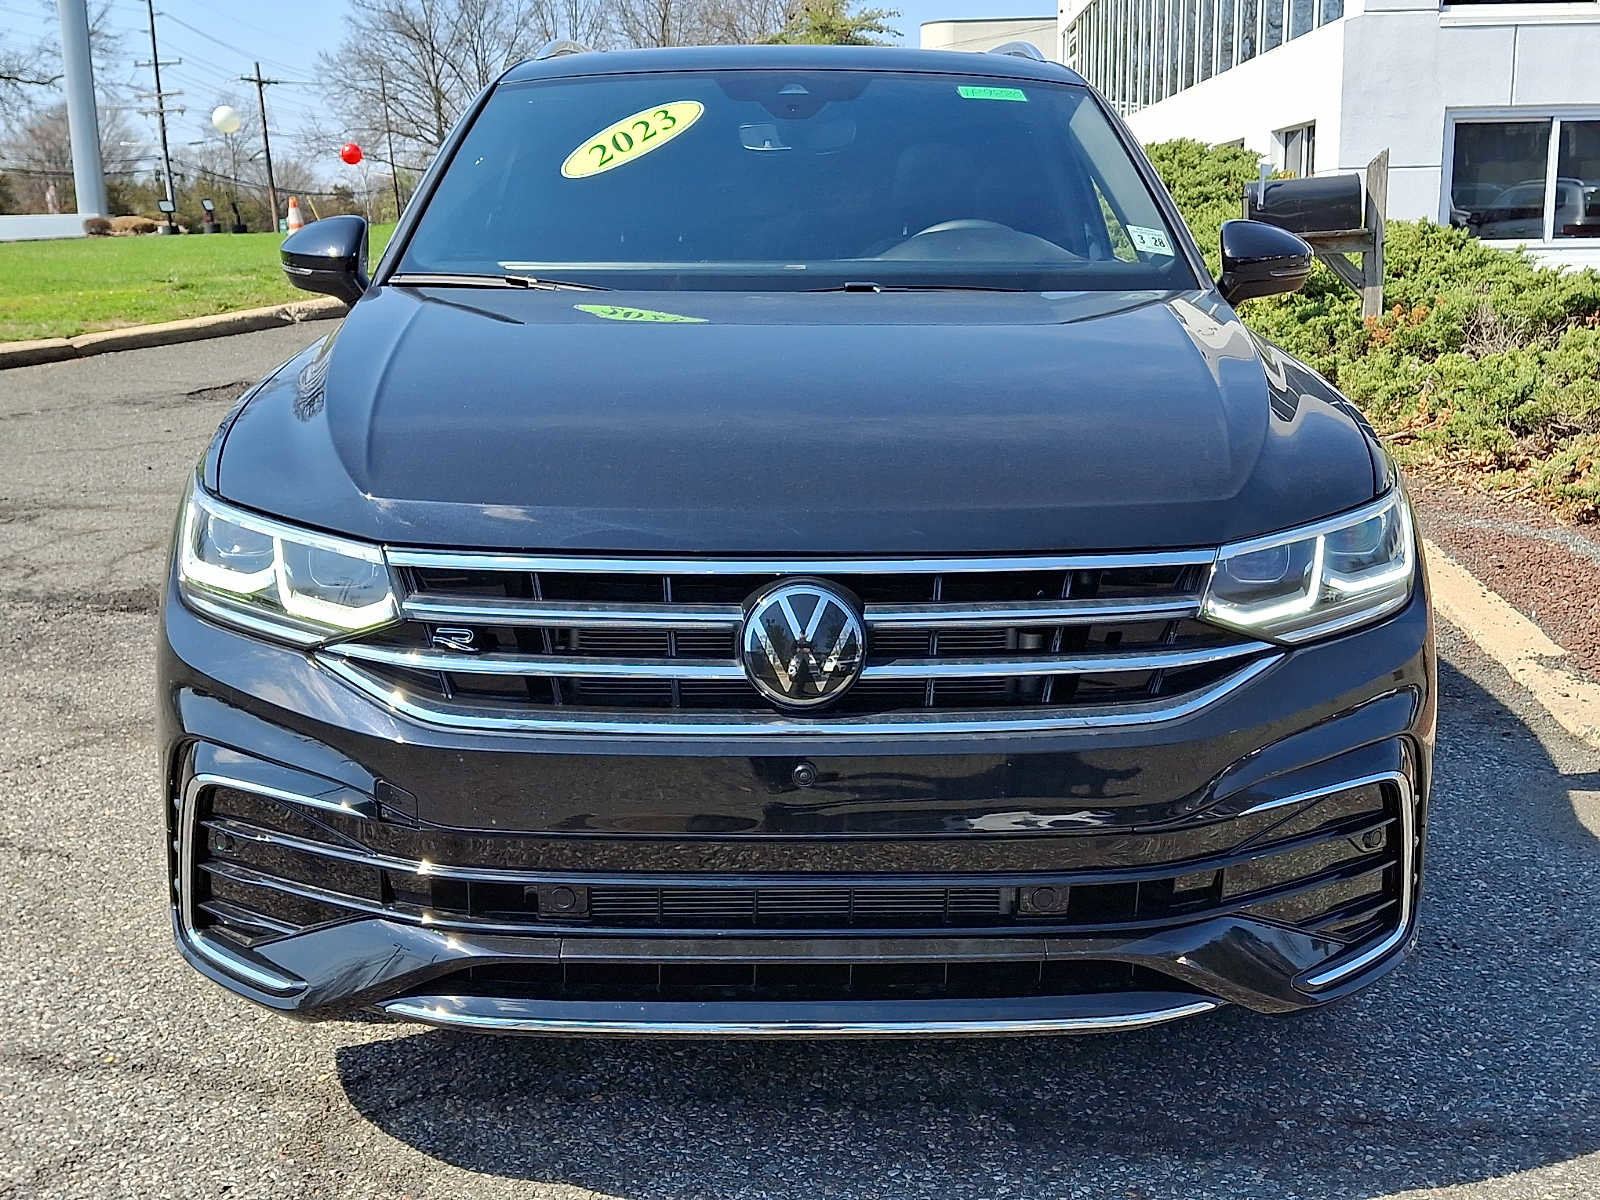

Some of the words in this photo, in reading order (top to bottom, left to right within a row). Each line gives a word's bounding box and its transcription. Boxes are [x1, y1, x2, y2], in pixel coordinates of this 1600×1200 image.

[588, 109, 676, 168] 2023
[1138, 235, 1145, 244] 3
[1152, 237, 1165, 247] 28
